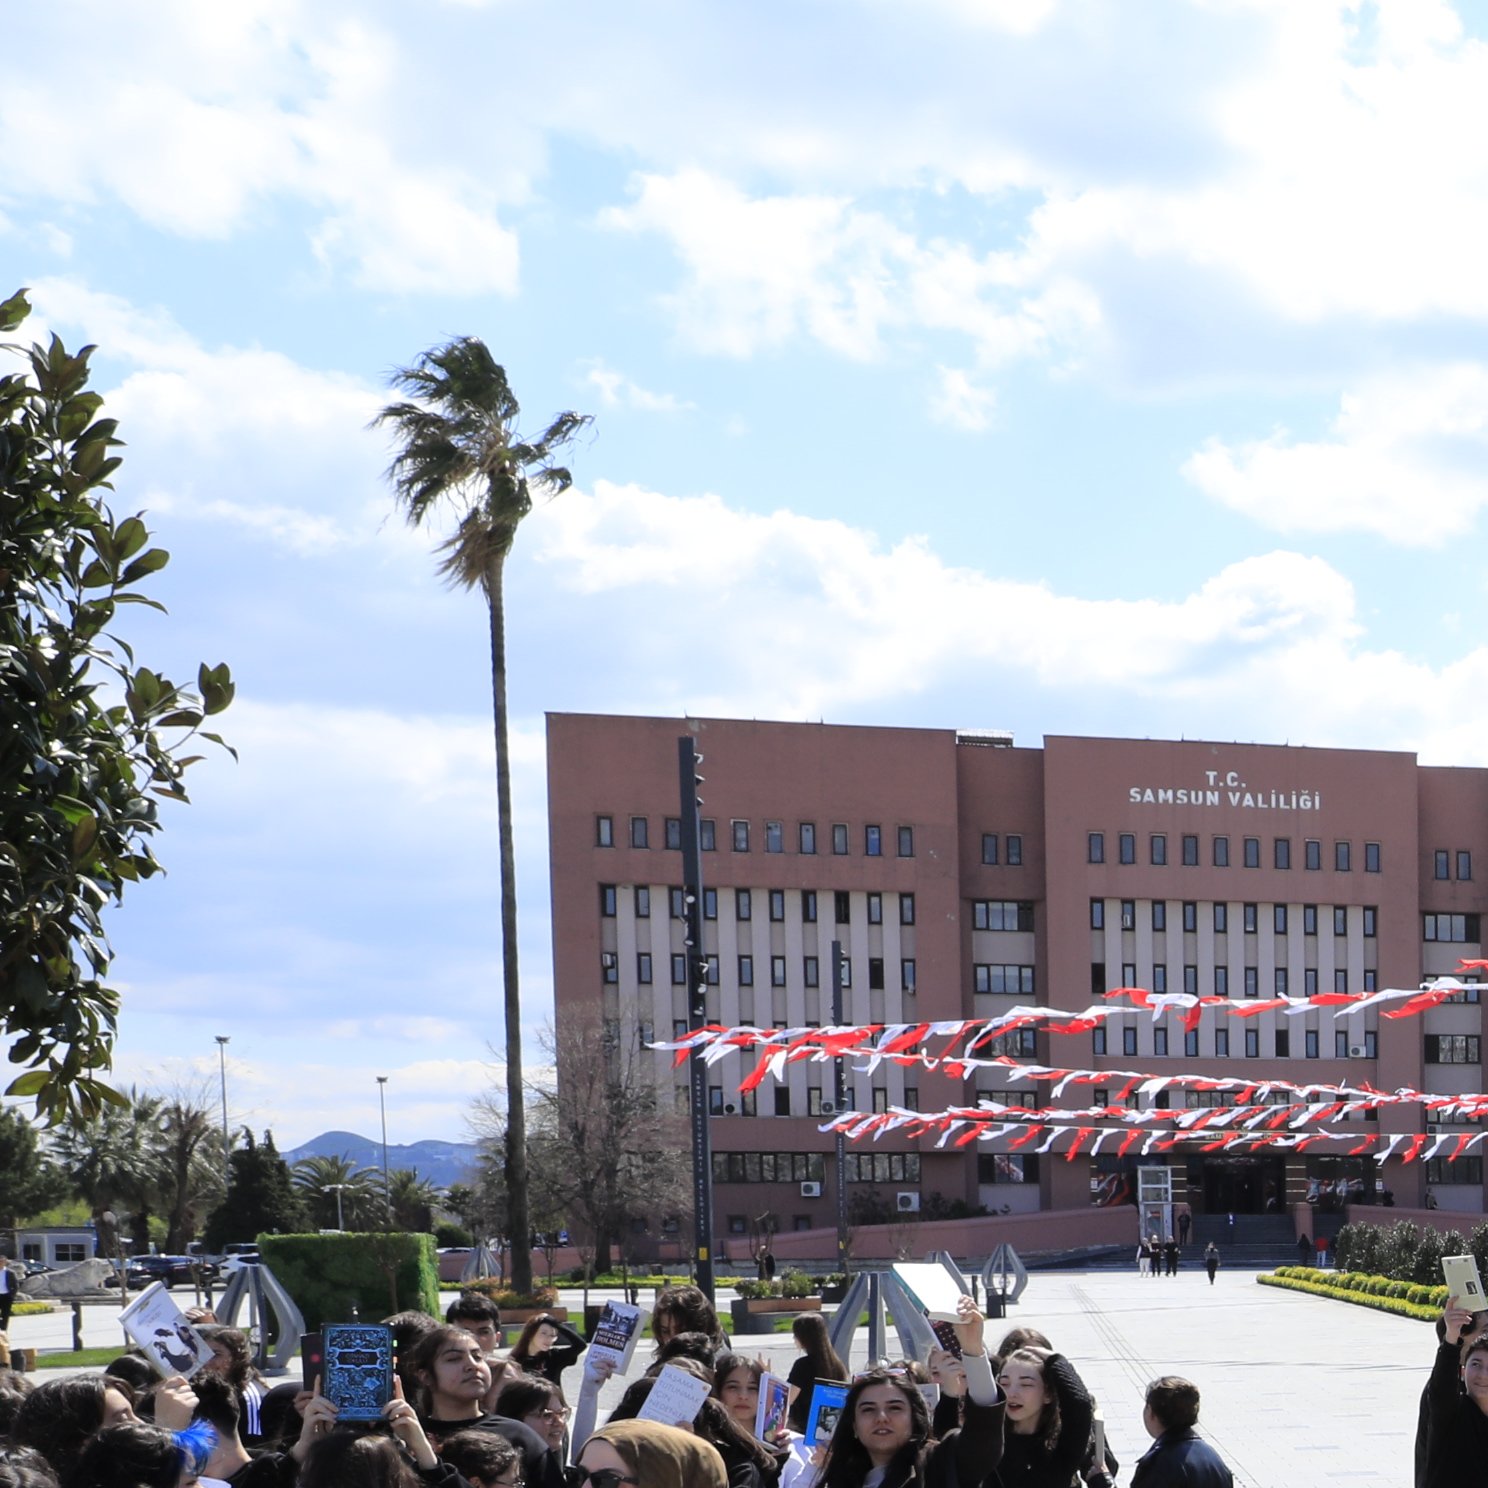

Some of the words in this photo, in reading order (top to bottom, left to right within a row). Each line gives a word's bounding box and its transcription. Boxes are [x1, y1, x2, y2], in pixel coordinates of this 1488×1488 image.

[1205, 770, 1247, 788] T.C.
[1129, 787, 1220, 807] SAMSUN
[1228, 789, 1321, 810] VALİLİĞİ
[596, 1335, 626, 1349] HOLMES
